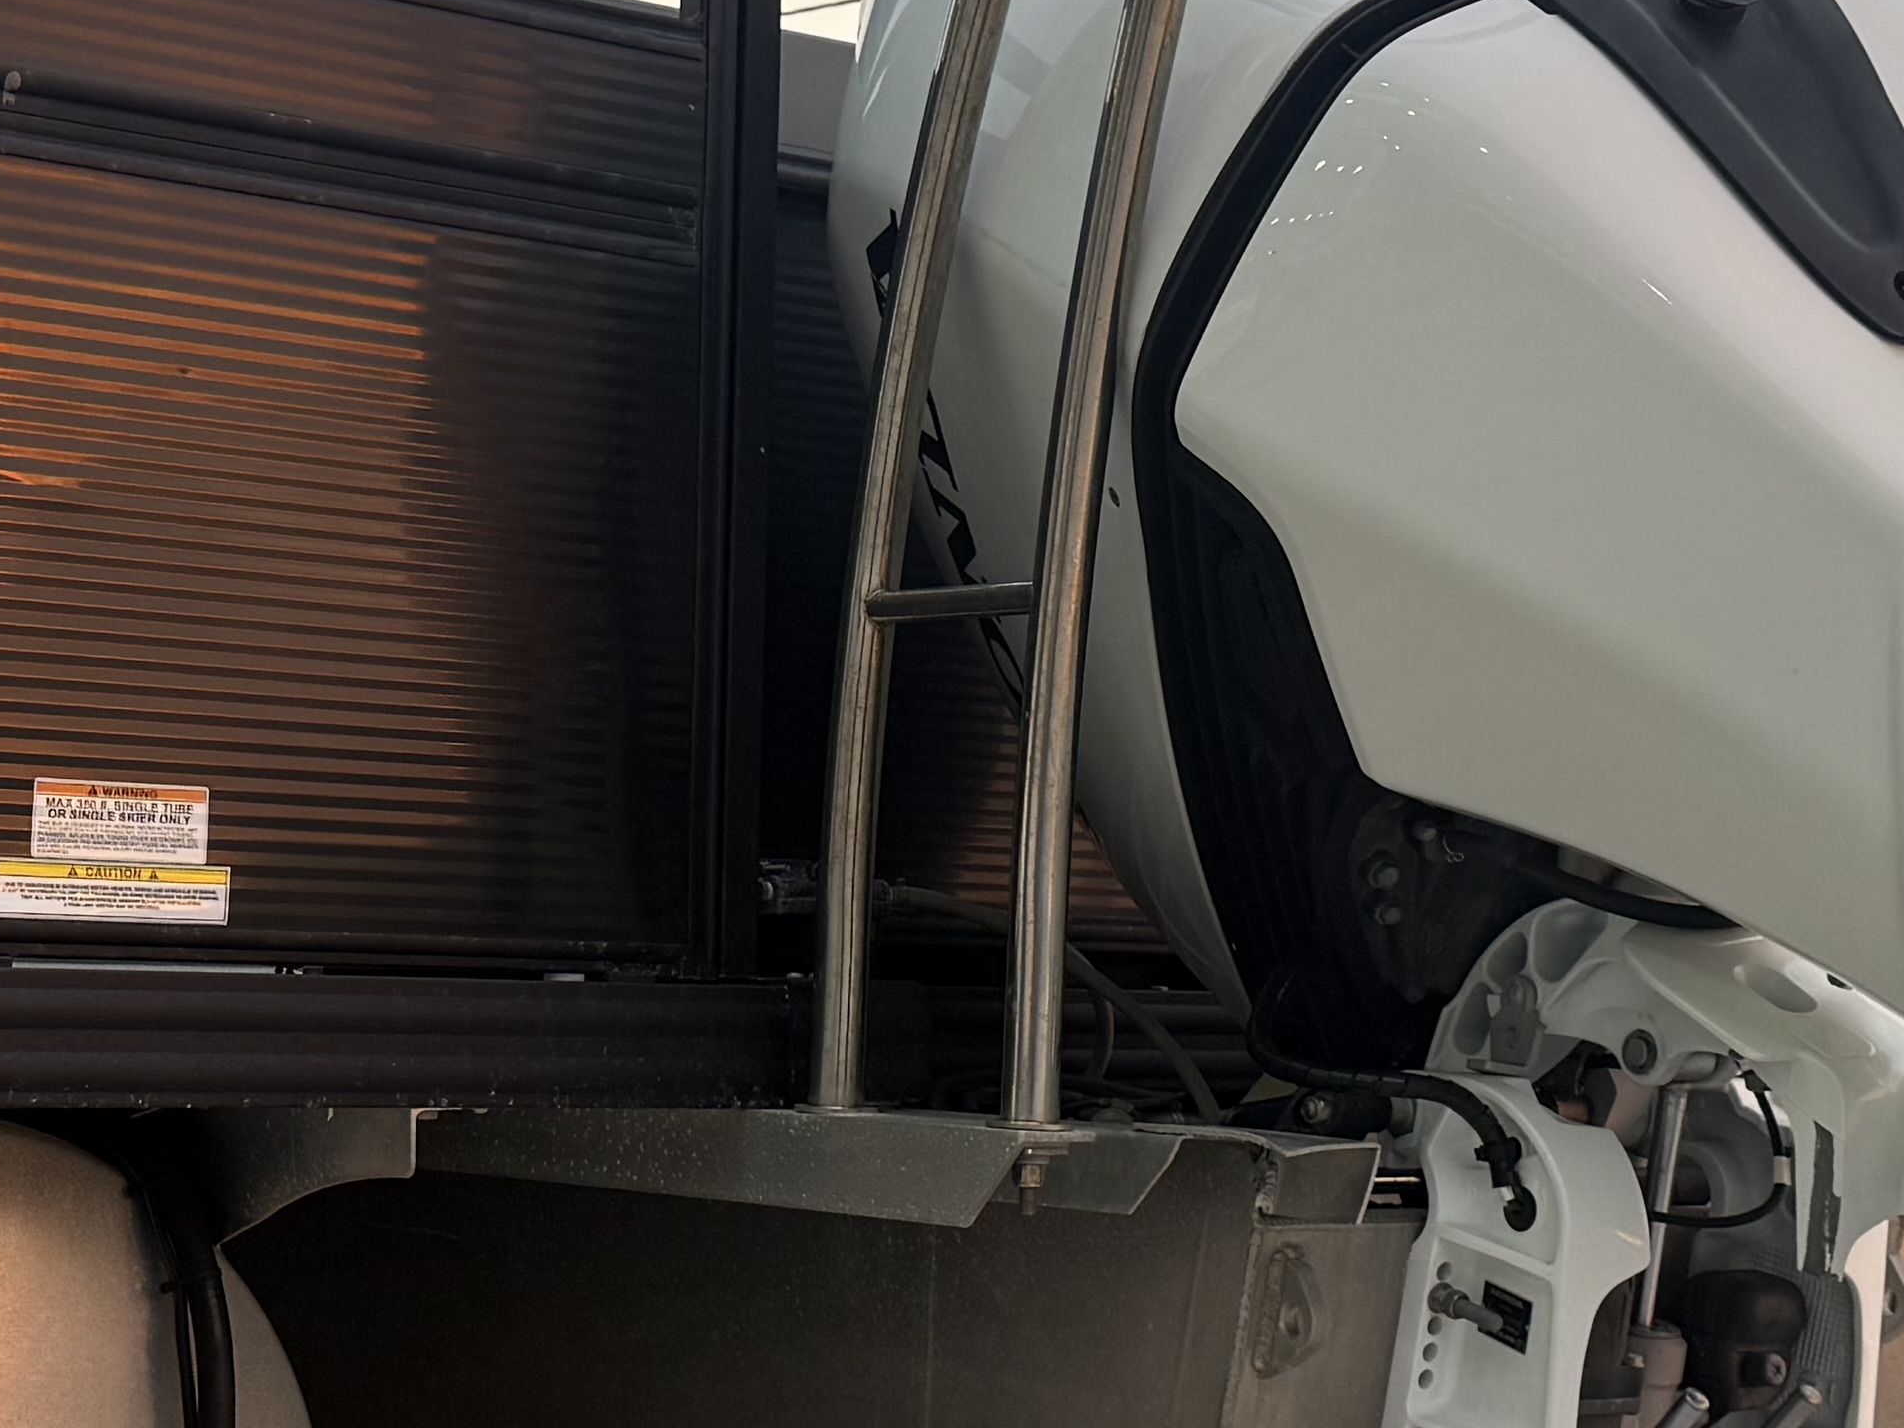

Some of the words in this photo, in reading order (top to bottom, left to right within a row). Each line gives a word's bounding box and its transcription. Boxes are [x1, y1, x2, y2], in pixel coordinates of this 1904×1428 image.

[102, 785, 158, 798] WARNING
[46, 797, 72, 808] MAX
[114, 801, 158, 813] SINGLE
[48, 808, 66, 819] OR
[69, 809, 116, 821] SINGLE
[119, 811, 156, 823] SKIER
[159, 813, 191, 825] ONLY
[85, 867, 141, 880] CAUTION
